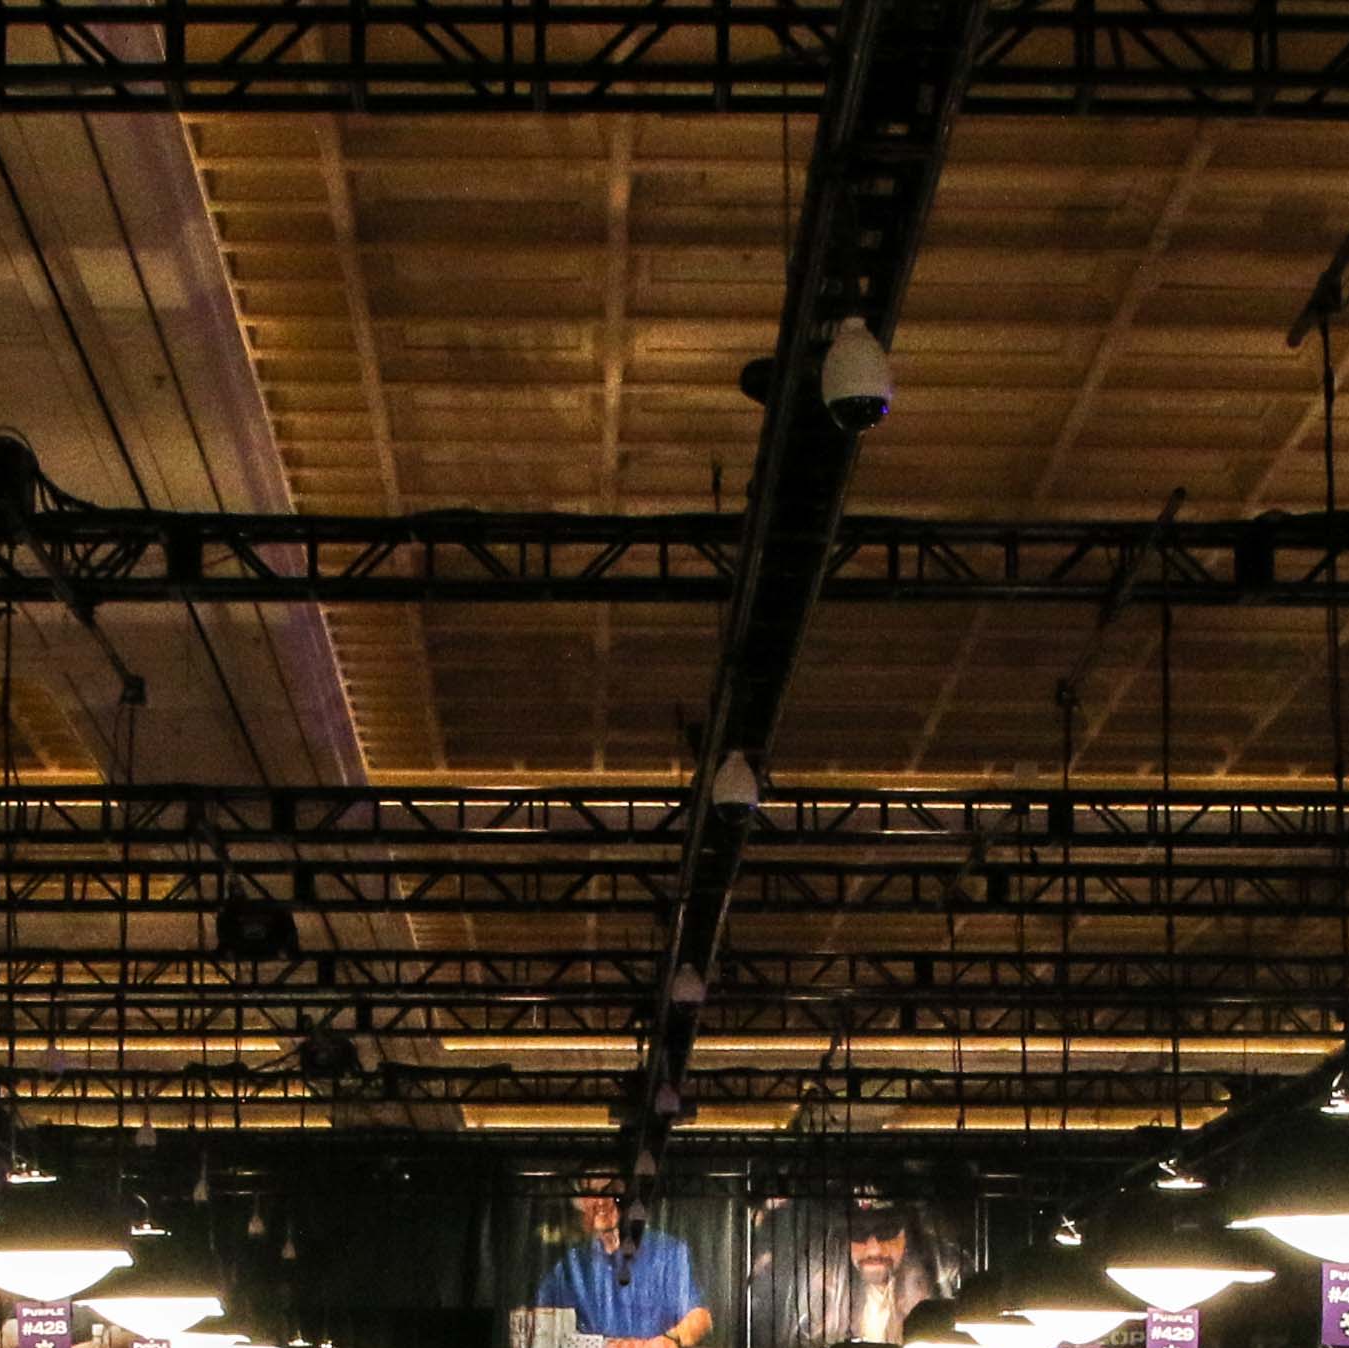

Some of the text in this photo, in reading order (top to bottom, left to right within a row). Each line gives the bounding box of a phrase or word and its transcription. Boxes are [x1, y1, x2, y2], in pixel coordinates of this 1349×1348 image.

[22, 1308, 65, 1317] PURPLE
[1152, 1313, 1194, 1323] PURPLE
[21, 1320, 68, 1335] #428
[1150, 1327, 1196, 1342] #429
